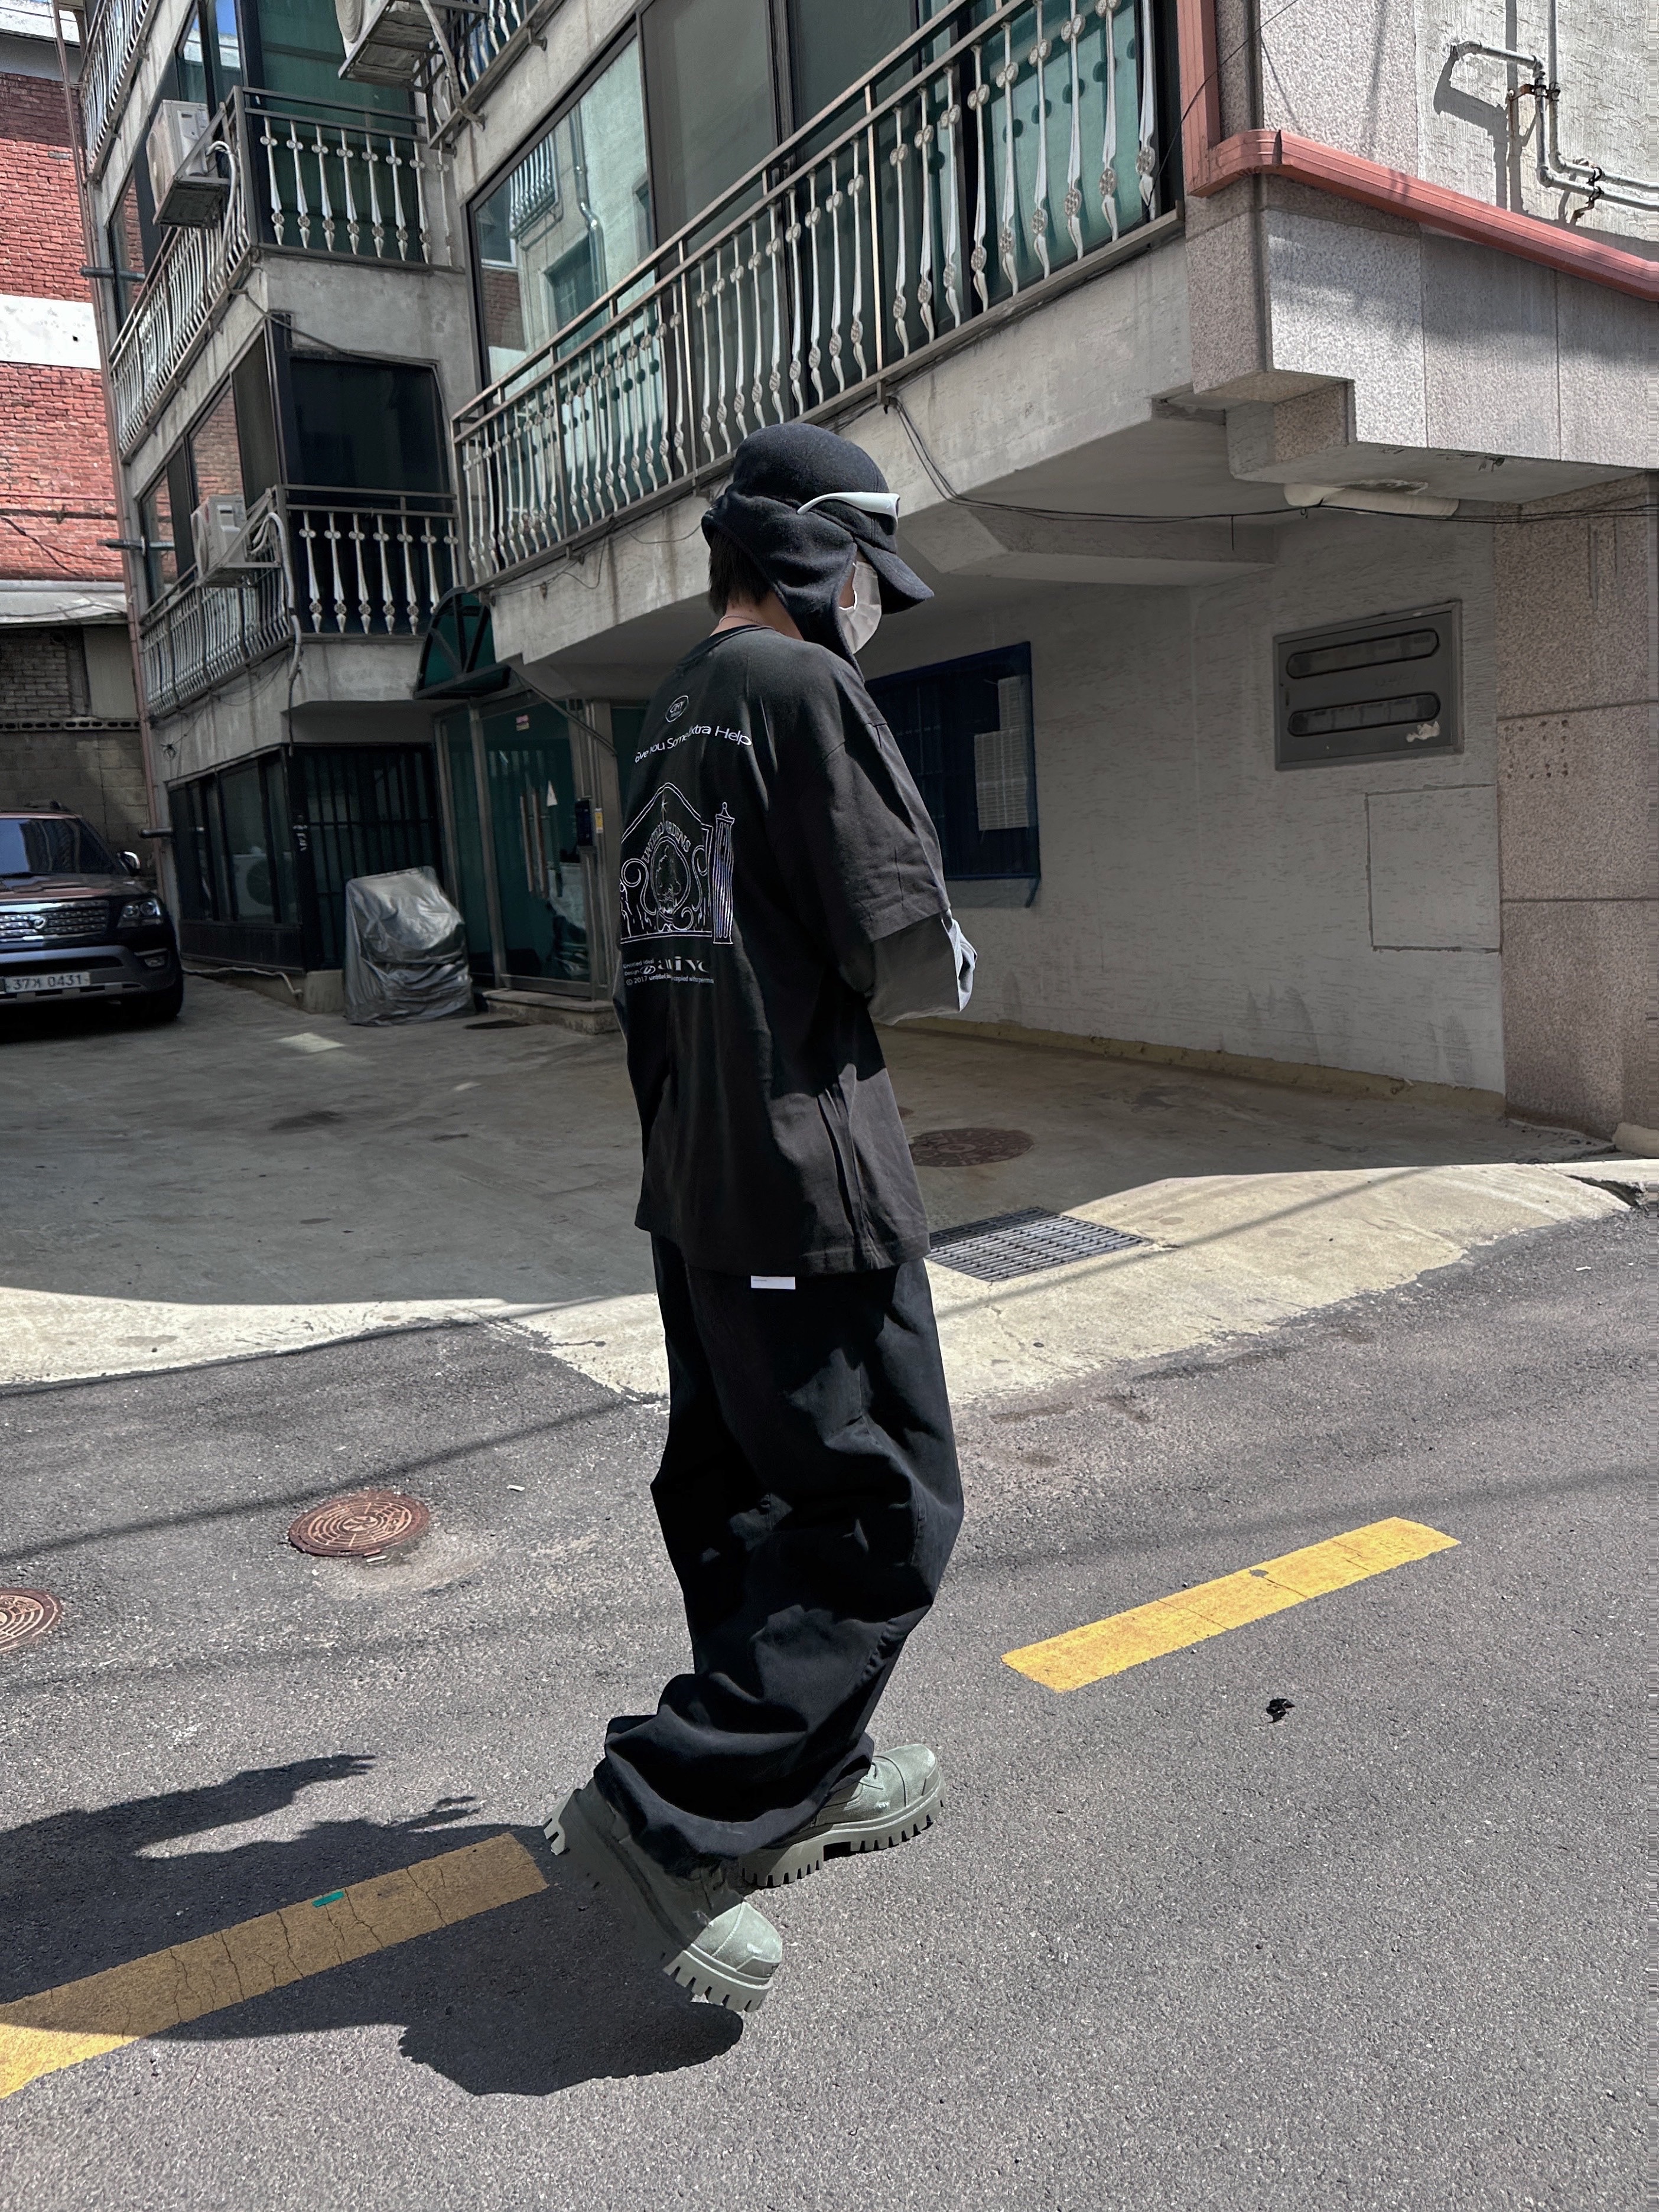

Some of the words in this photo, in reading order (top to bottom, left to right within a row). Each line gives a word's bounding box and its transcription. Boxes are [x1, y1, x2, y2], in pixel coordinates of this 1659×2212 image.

[714, 726, 752, 746] Help
[48, 974, 81, 987] 0431
[633, 975, 648, 984] 2017
